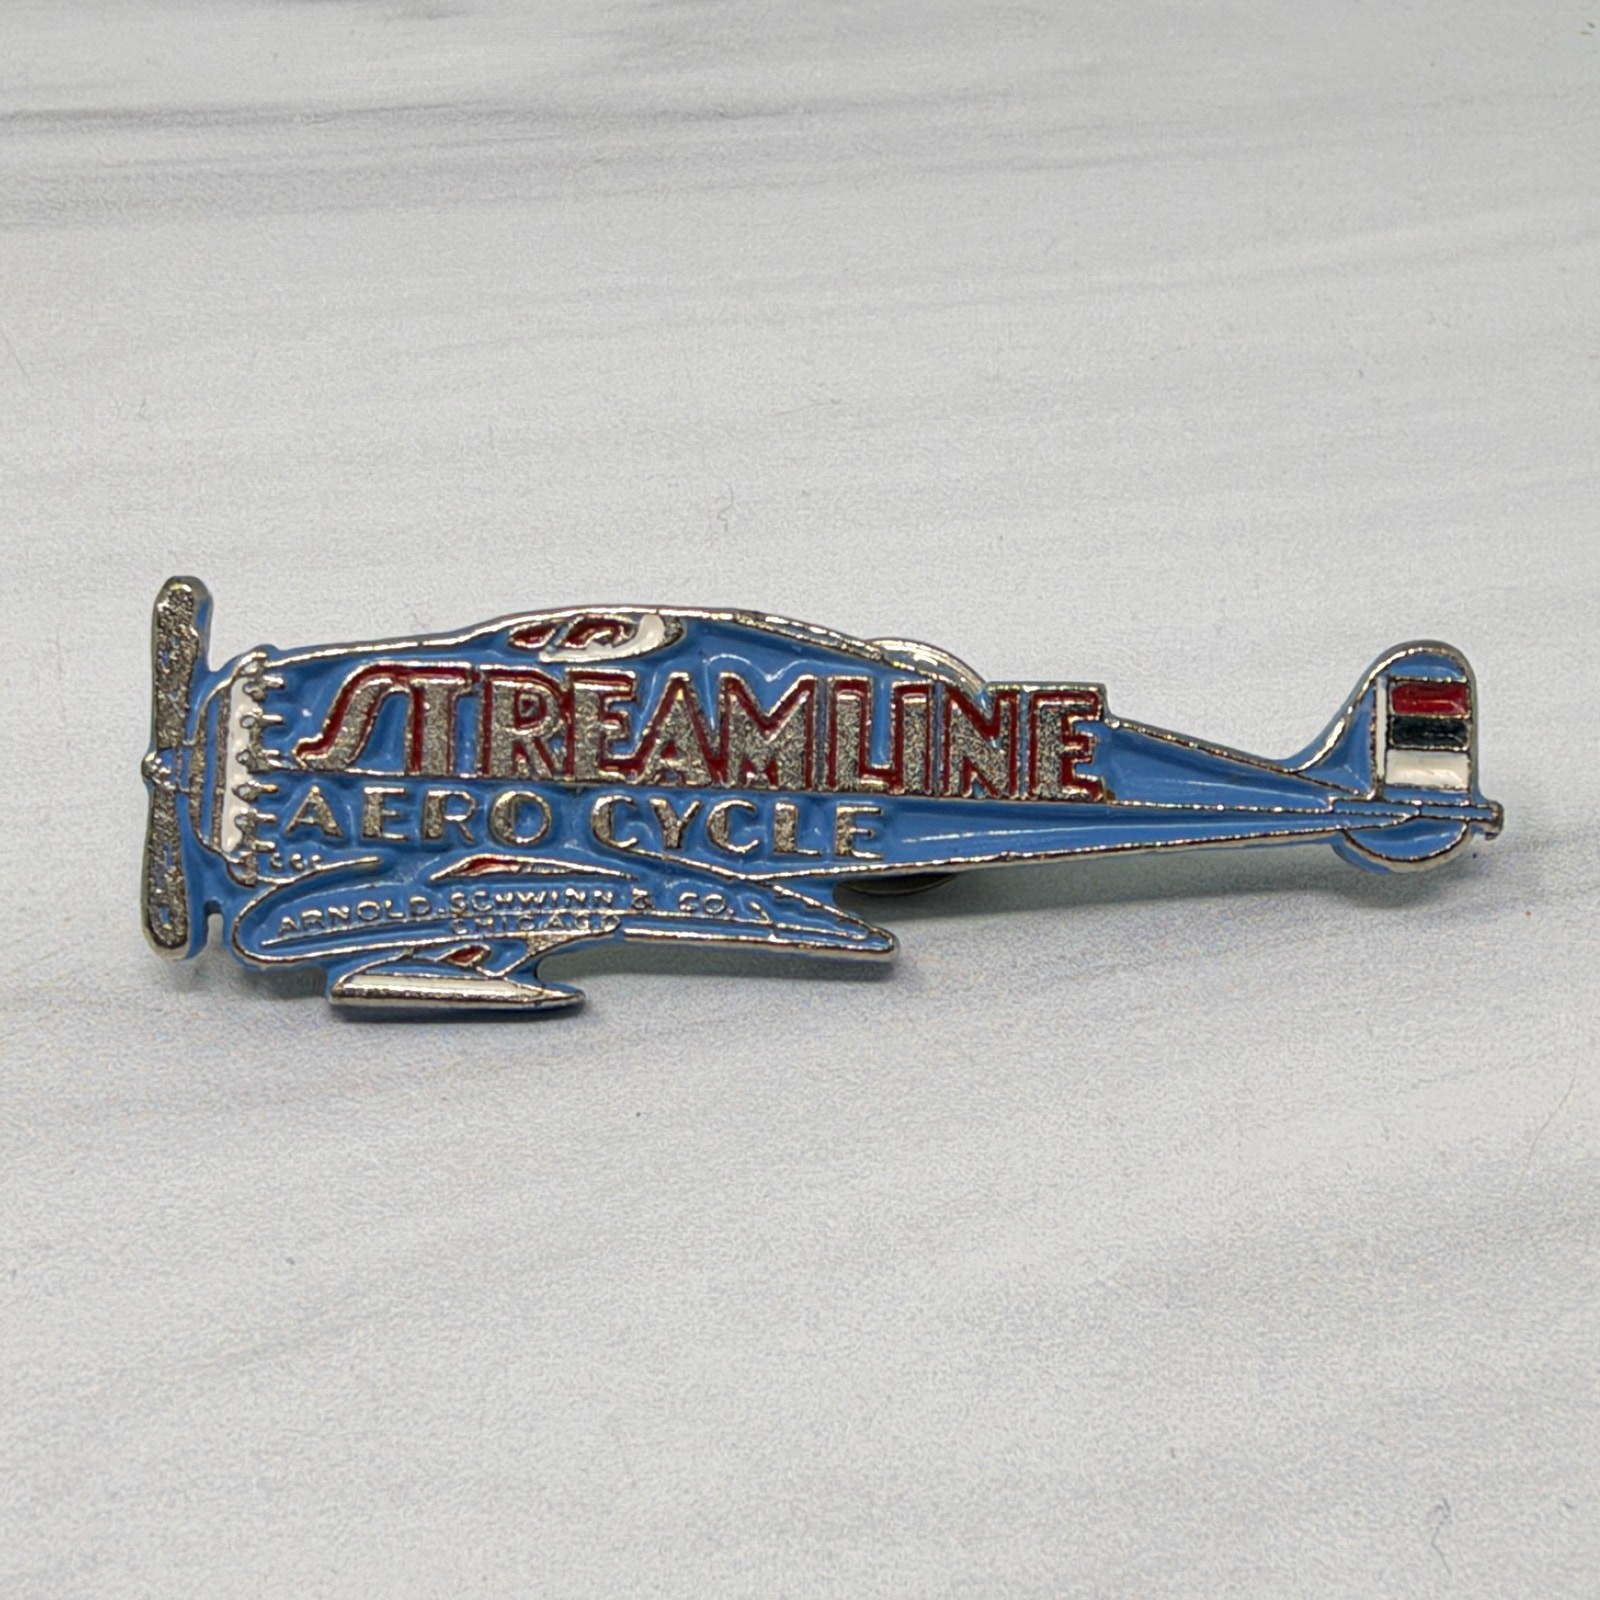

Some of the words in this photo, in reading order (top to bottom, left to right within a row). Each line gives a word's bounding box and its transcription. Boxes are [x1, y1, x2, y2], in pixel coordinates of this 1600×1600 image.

[292, 660, 1105, 803] STREAMLINE
[285, 784, 553, 846] AERO
[591, 794, 884, 860] CYCLE
[450, 886, 614, 914] SCHWINN
[451, 913, 622, 936] CHICAGO
